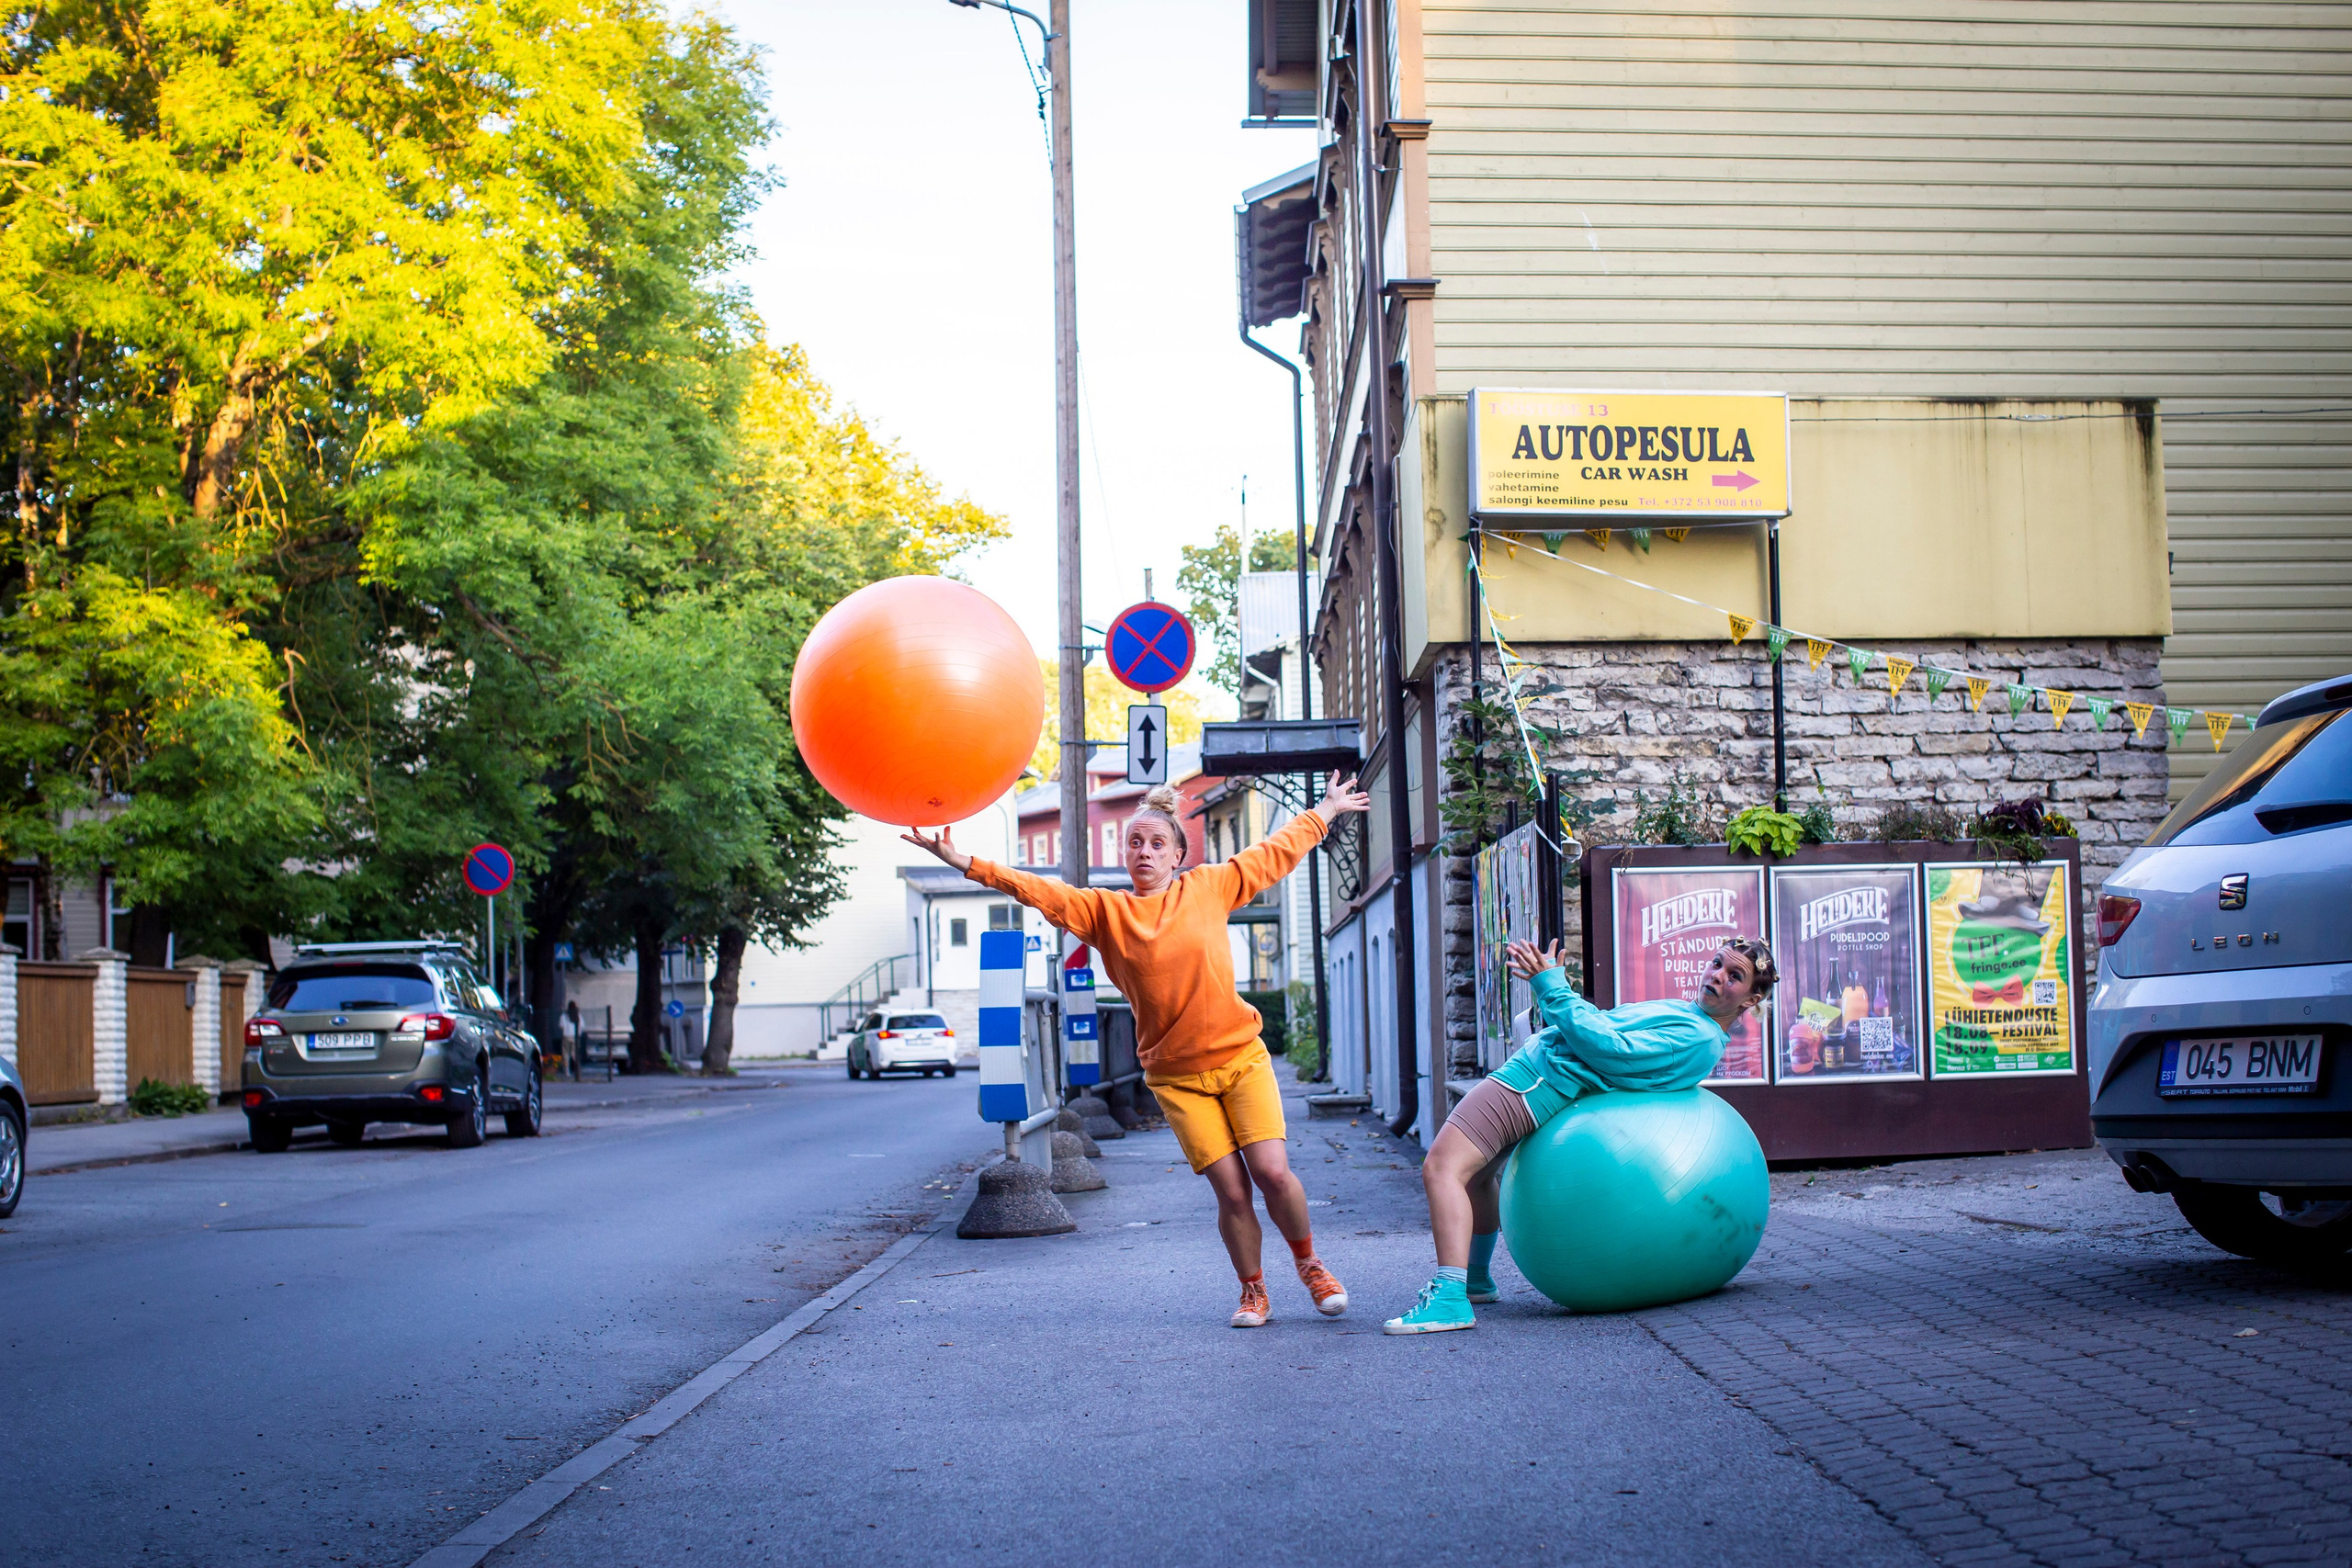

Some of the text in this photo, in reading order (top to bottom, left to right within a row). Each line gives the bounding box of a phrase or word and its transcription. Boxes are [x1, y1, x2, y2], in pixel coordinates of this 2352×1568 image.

[1589, 404, 1608, 416] 13
[1511, 424, 1756, 462] AUTOPESULA
[1488, 469, 1560, 479] poleerimine
[1581, 467, 1688, 480] CAR WASH
[1488, 483, 1559, 492] vahetamine
[1488, 495, 1532, 506] salongi
[1537, 496, 1596, 505] keemiline
[1638, 497, 1659, 506] Tel.
[1665, 498, 1692, 506] +372
[1697, 499, 1711, 507] 53
[1714, 499, 1736, 507] 908
[1731, 620, 1749, 632] TFF
[1770, 632, 1788, 645] TFF
[1810, 641, 1828, 652] TFF
[1850, 652, 1869, 664] TFF
[1890, 665, 1908, 676] TFF
[2010, 688, 2029, 700] TFF
[1830, 931, 1890, 942] PUDELIPOOD
[2191, 931, 2279, 951] LEON
[1961, 933, 2005, 960] TFF
[1971, 959, 2027, 974] fringe.ee
[1945, 1007, 2058, 1024] LÜHIETENDUSTE
[2002, 1023, 2059, 1037] FESTIVAL
[318, 1033, 339, 1046] 509
[1945, 1040, 1988, 1055] 18.09
[2186, 1039, 2314, 1079] 045 BNM
[2161, 1070, 2176, 1081] EST
